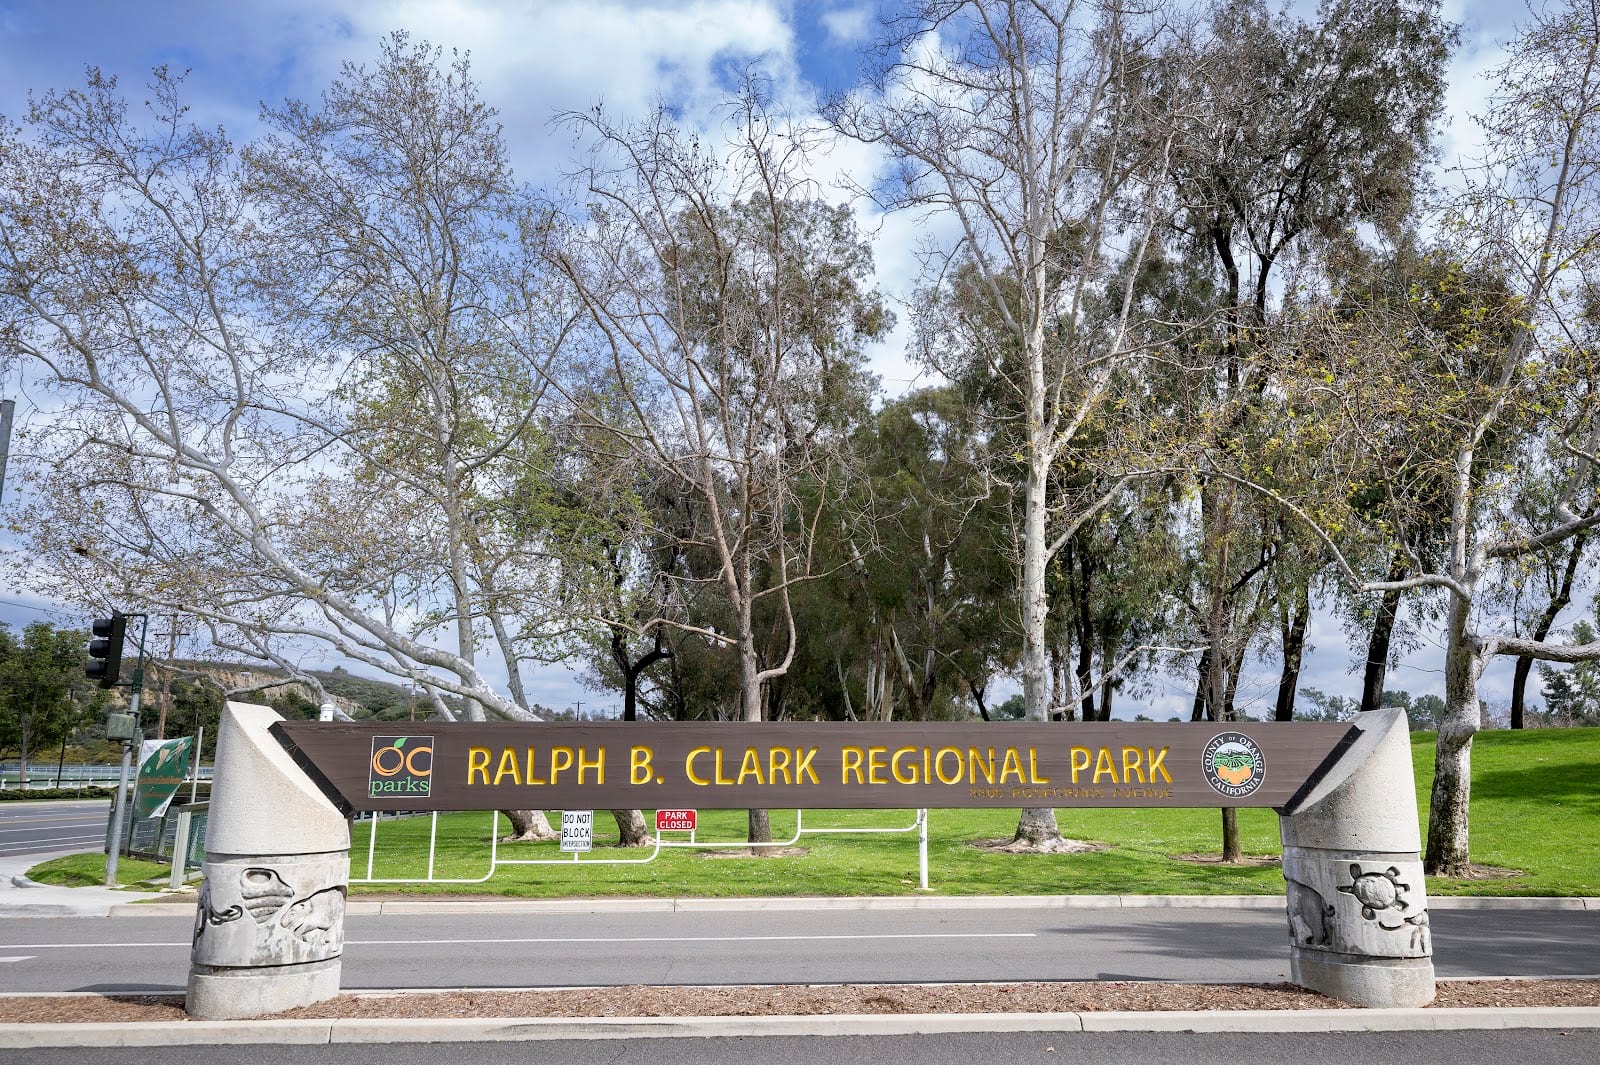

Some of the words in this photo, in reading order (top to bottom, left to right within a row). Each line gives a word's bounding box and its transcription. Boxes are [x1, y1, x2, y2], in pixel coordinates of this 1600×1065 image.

[372, 746, 432, 777] OC
[1205, 736, 1225, 773] COUNTY
[1239, 737, 1263, 774] ORANGE
[466, 745, 606, 785] RALPH
[630, 745, 665, 785] B.
[685, 745, 820, 786] CLARK
[841, 746, 1050, 785] REGIONAL
[1070, 745, 1174, 784] PARK
[370, 776, 429, 796] parks
[1112, 787, 1174, 798] AVENUE
[1211, 776, 1261, 796] CALIFORNIA
[564, 814, 574, 824] DO
[577, 814, 590, 824] NOT
[665, 811, 687, 820] PARK
[660, 821, 692, 829] CLOSED
[563, 828, 590, 838] BLOCK
